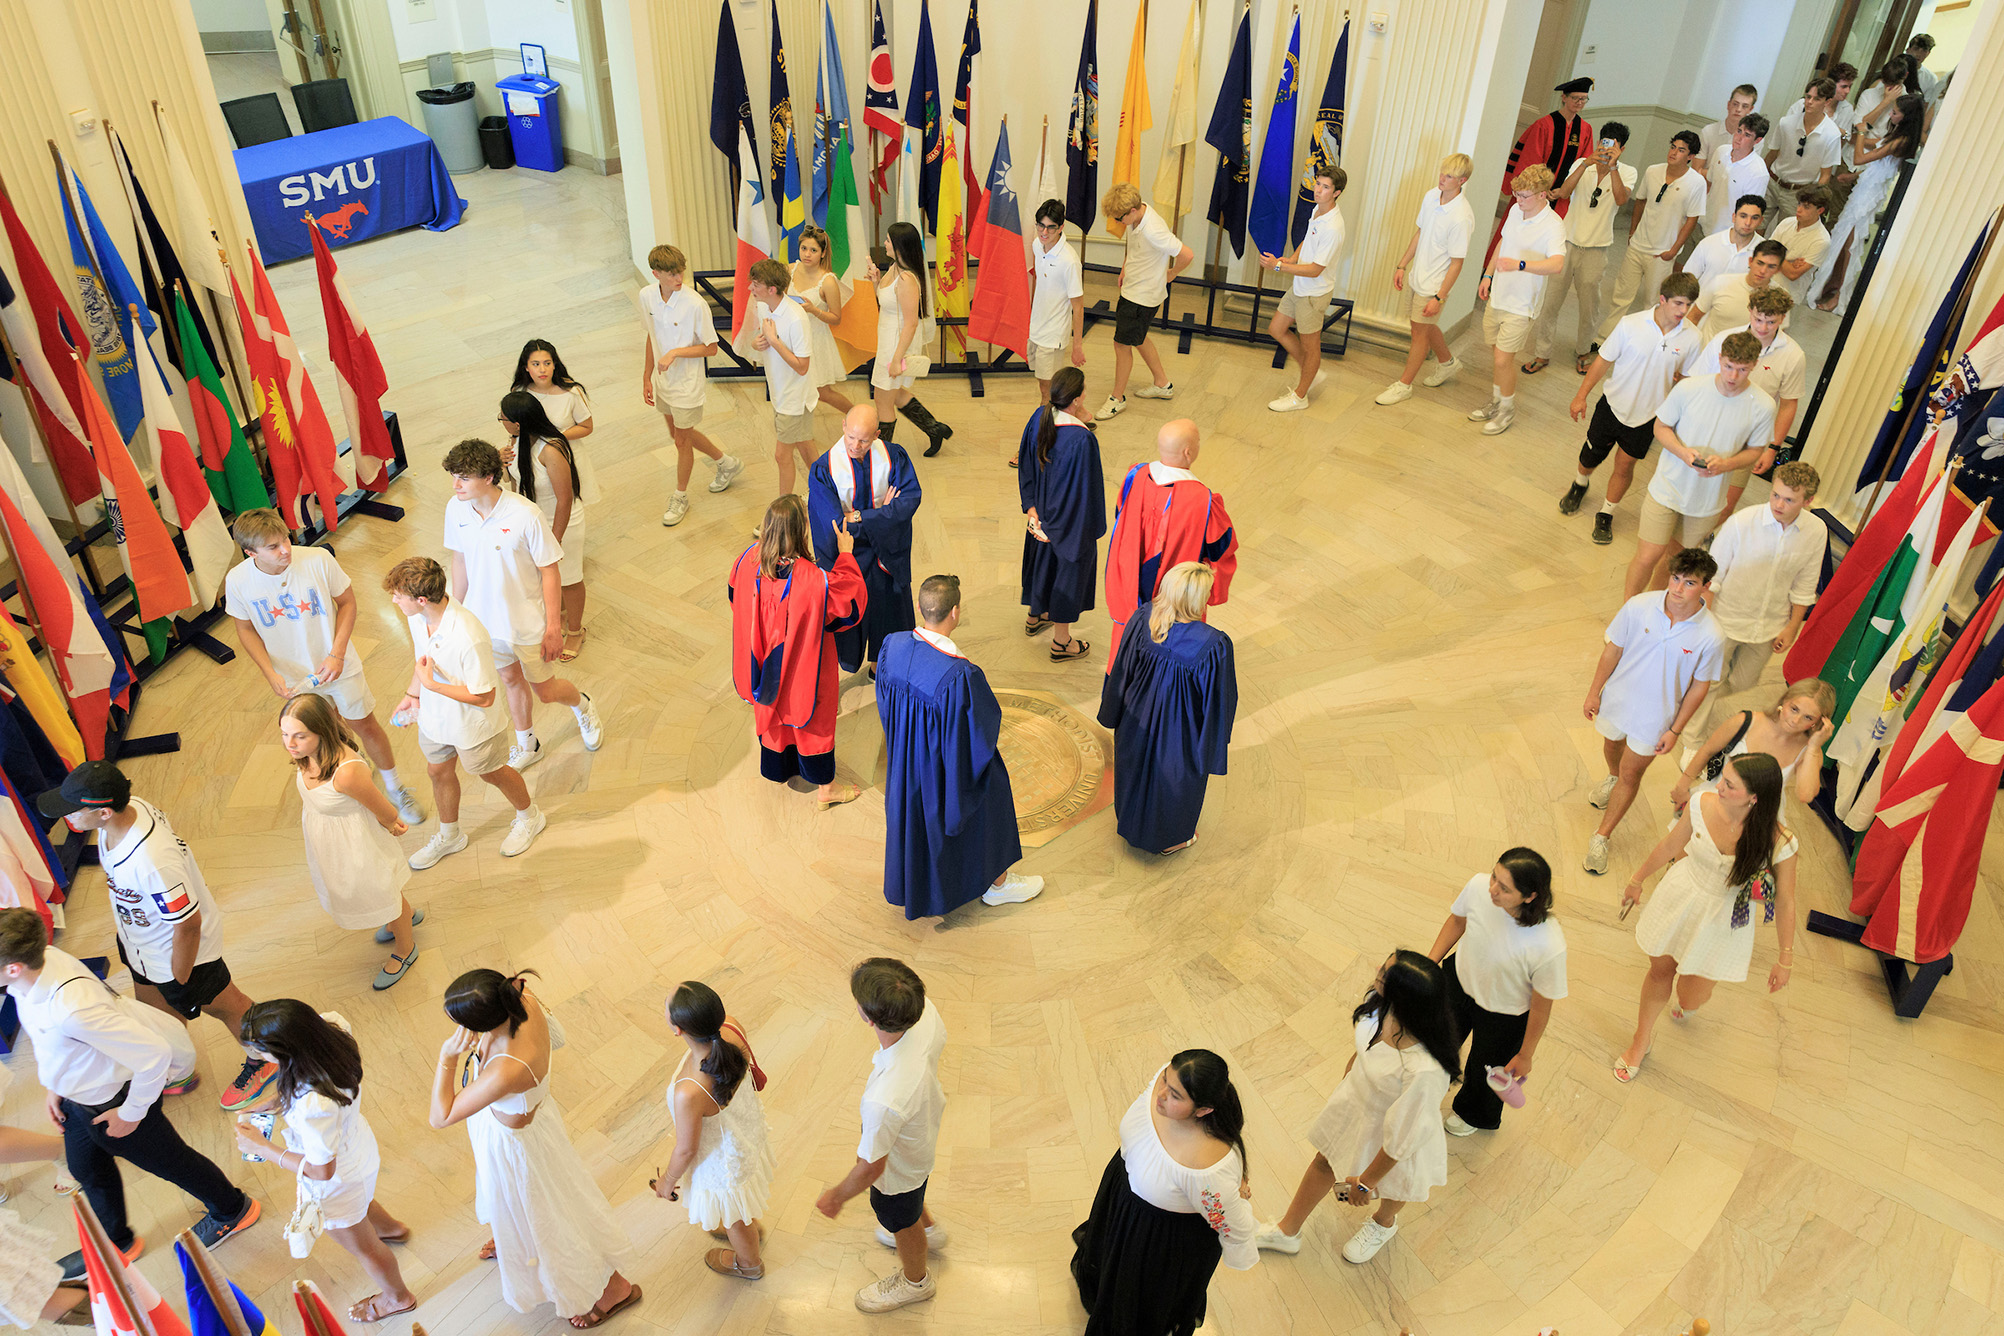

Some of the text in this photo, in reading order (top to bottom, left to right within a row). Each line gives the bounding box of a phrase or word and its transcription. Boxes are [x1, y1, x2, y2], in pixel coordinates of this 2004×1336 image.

[279, 157, 376, 208] SMU
[1009, 699, 1101, 834] METHODIST UNIVERSIT
